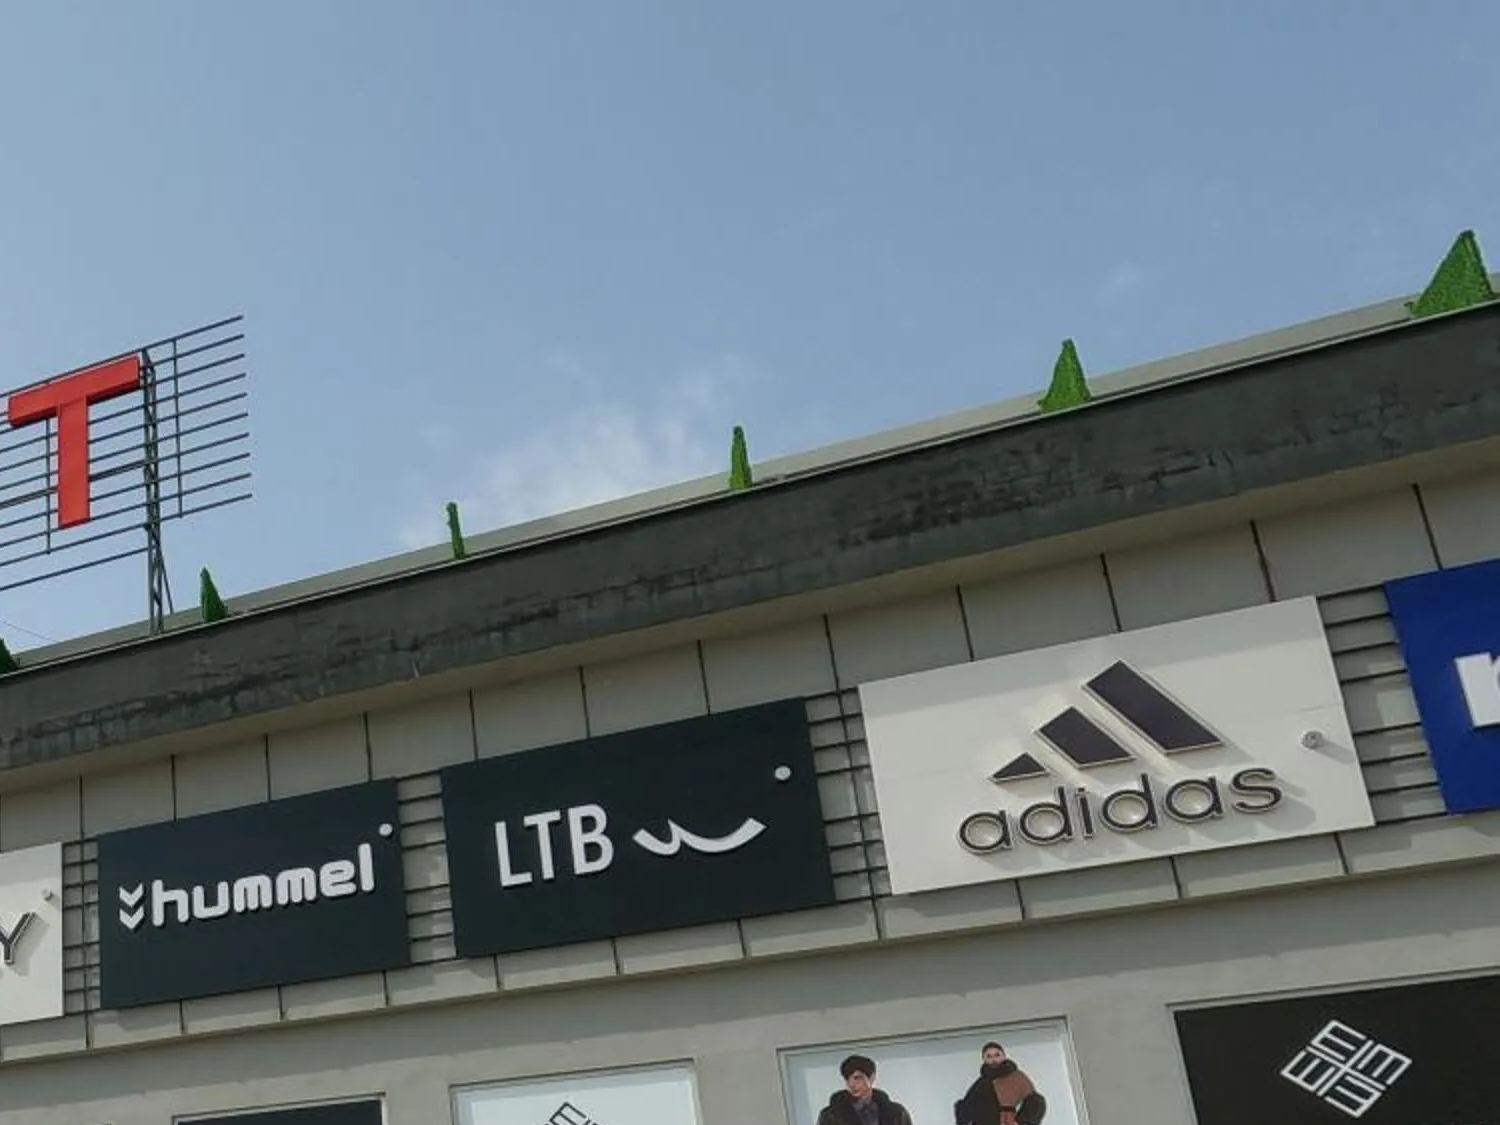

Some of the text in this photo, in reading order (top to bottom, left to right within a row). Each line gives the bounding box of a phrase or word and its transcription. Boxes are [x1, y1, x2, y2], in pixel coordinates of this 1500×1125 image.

[495, 804, 615, 887] LTB
[958, 767, 1284, 856] adidas
[152, 844, 374, 927] hummel
